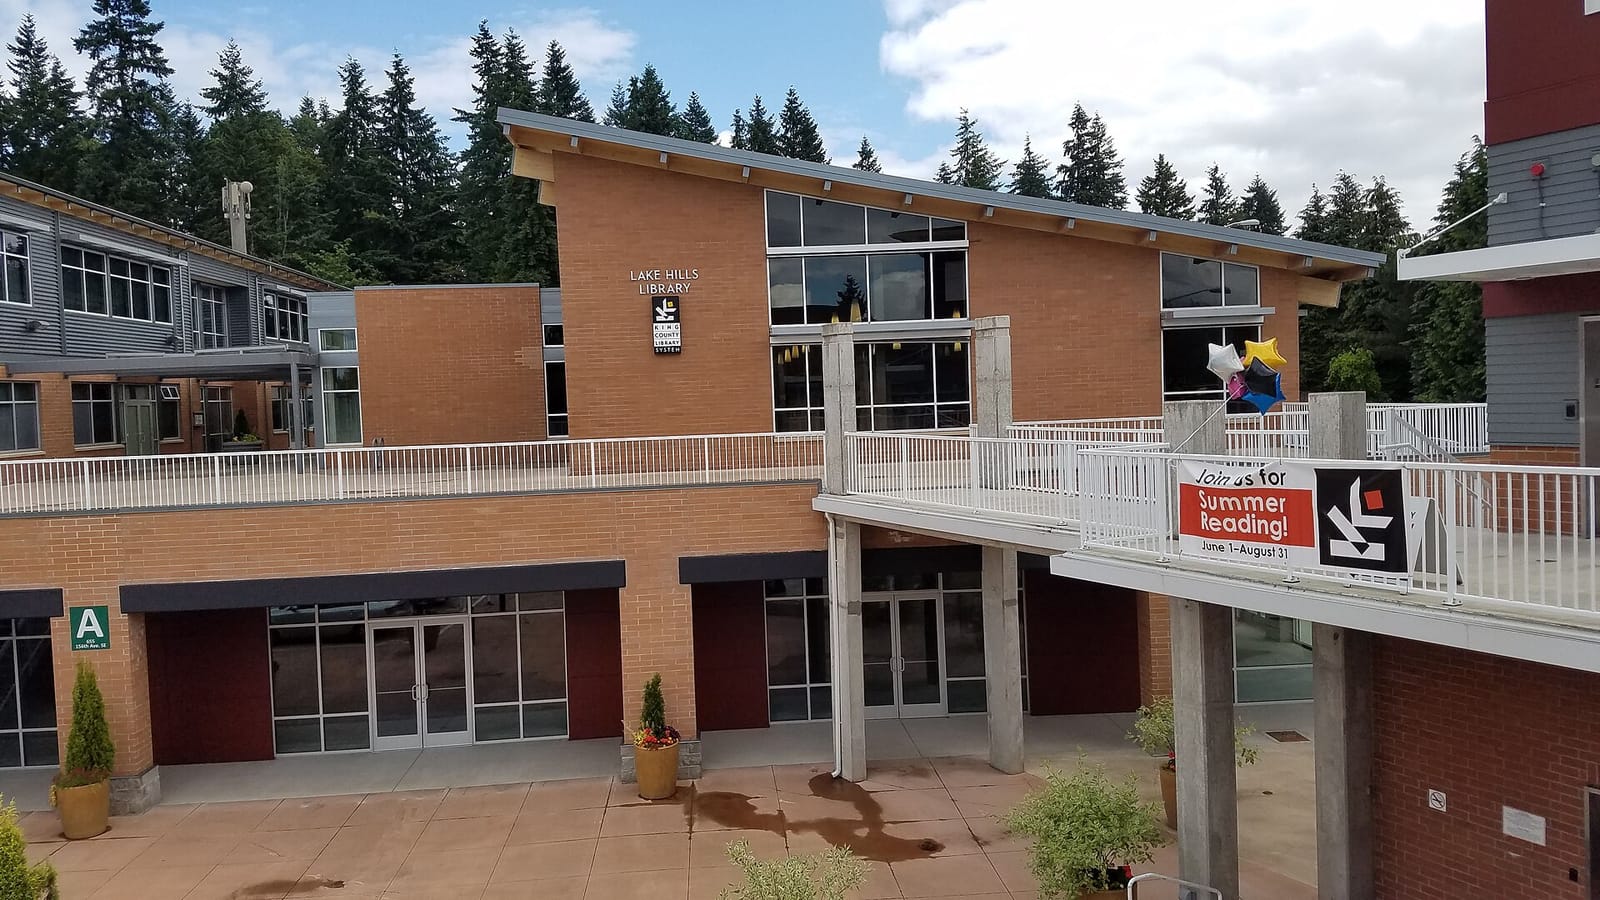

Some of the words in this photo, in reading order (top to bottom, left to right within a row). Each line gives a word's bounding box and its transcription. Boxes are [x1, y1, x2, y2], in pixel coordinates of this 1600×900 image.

[630, 270, 661, 281] LAKE
[665, 269, 699, 280] HILLS
[639, 283, 691, 294] LIBRARY
[1196, 469, 1230, 485] Join
[1234, 474, 1254, 486] us
[1259, 468, 1286, 485] for
[1199, 489, 1286, 513] Summer
[1200, 511, 1288, 541] Reading!
[1202, 540, 1225, 552] June
[1278, 547, 1288, 559] 31
[76, 609, 104, 638] A
